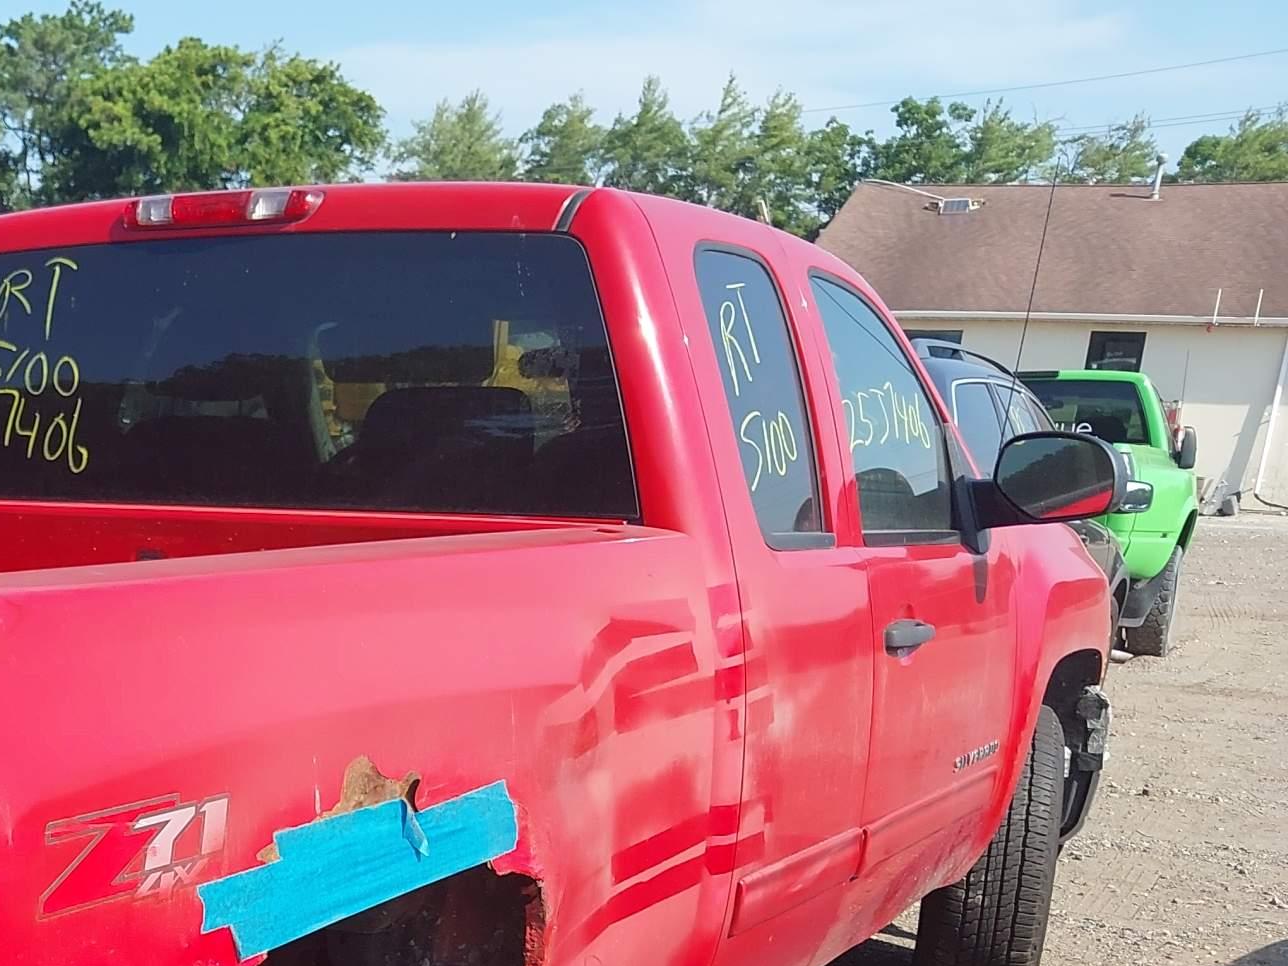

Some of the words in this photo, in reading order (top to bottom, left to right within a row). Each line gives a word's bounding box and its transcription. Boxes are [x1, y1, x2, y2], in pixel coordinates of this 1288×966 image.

[720, 283, 760, 396] RT
[841, 381, 931, 453] 25J7406
[952, 739, 1000, 773] SILVERADO
[36, 792, 230, 922] Z71
